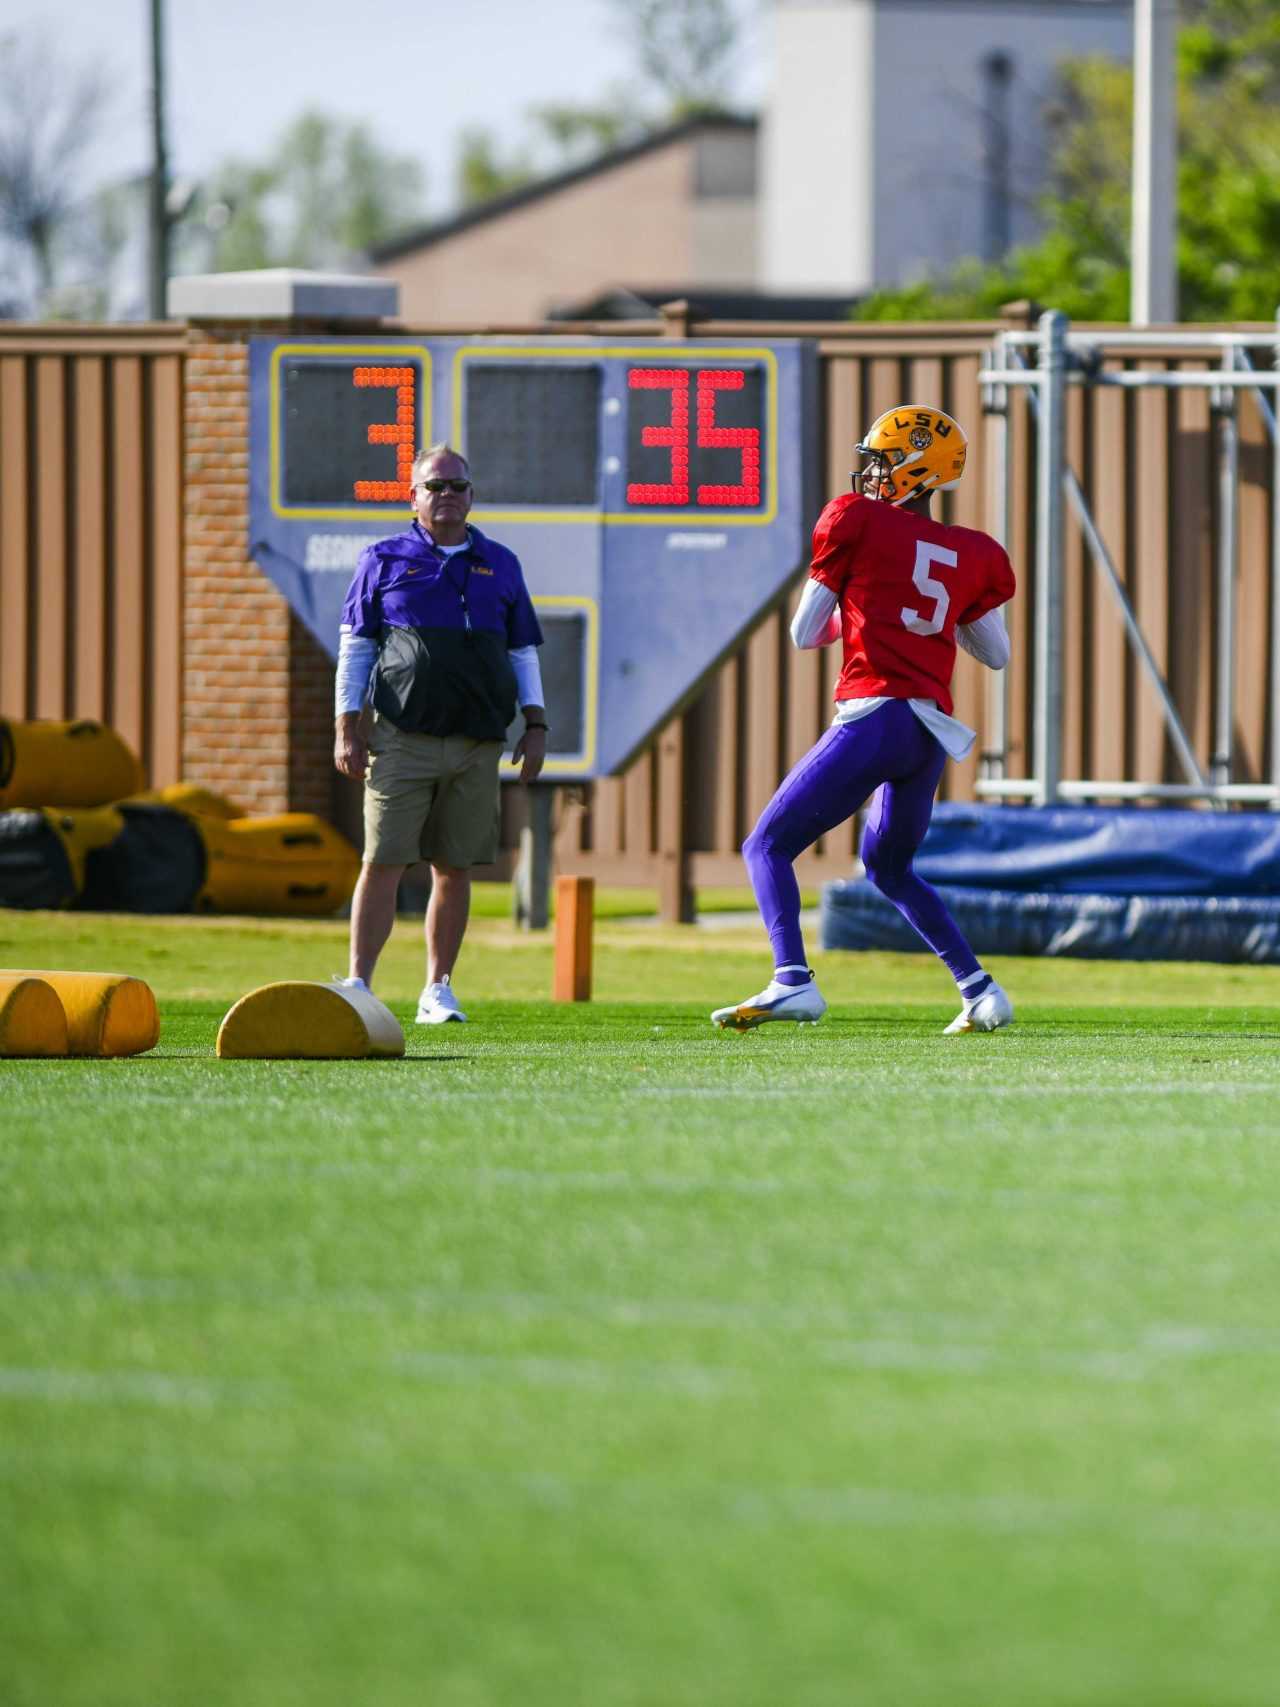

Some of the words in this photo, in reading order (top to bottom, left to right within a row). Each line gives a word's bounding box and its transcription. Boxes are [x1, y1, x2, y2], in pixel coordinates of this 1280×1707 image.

[353, 367, 414, 501] 3
[895, 413, 952, 438] LSU
[901, 539, 958, 636] 5
